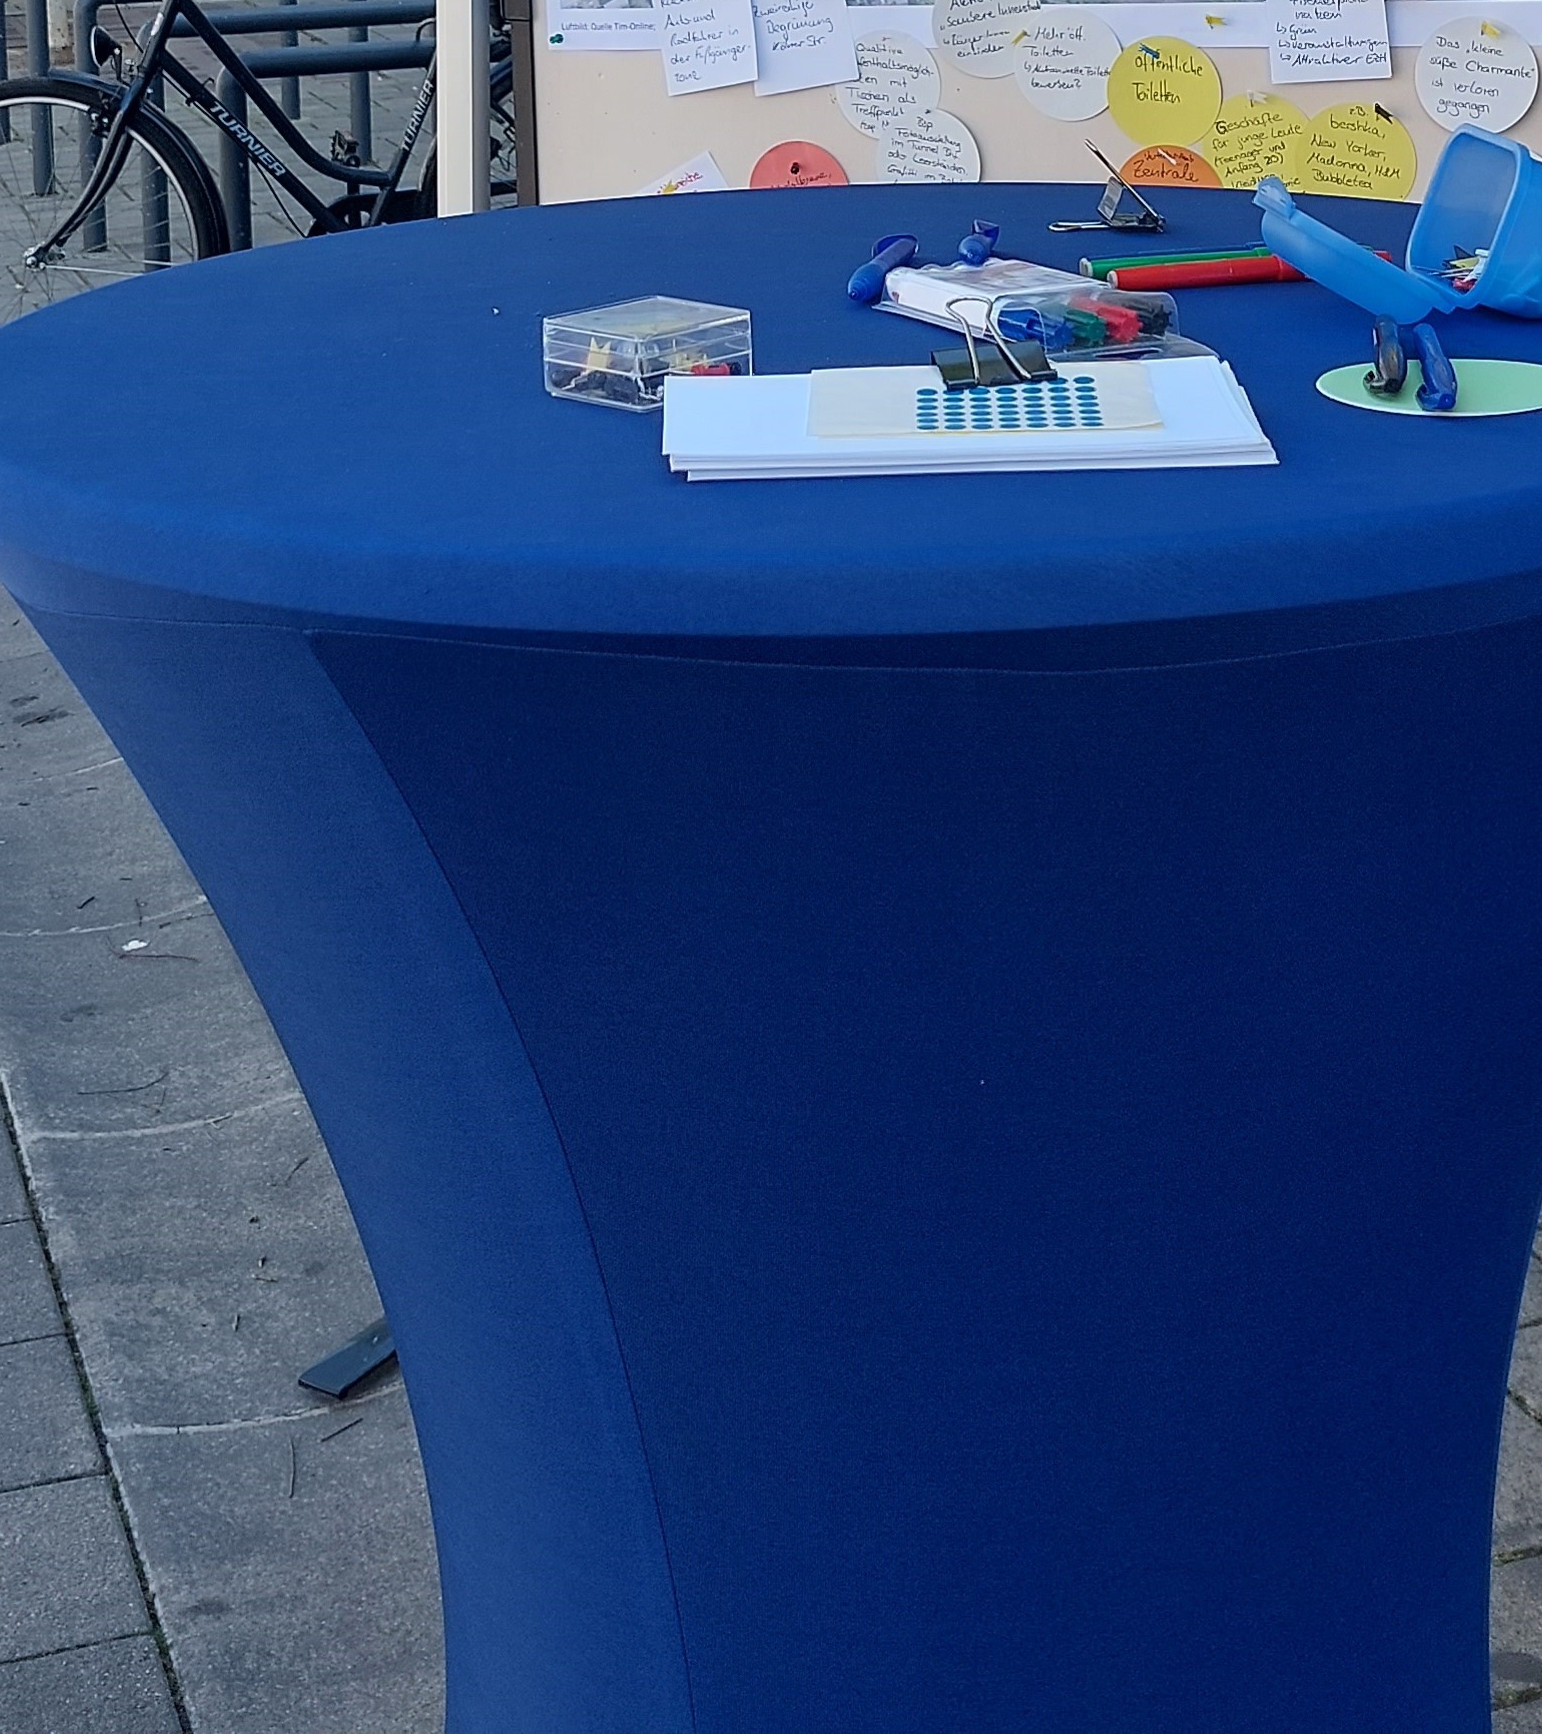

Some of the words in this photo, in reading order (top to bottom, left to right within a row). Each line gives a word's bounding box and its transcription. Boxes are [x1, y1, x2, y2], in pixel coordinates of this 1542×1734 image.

[1436, 36, 1459, 48] Das
[1429, 57, 1457, 70] süße
[1432, 78, 1443, 87] ist
[1454, 81, 1499, 97] verloren
[402, 79, 435, 152] TURNIER
[1437, 98, 1489, 119] gegangen
[1216, 112, 1284, 136] Geschäfte
[209, 100, 286, 176] TURNIER
[1212, 139, 1229, 151] für
[1237, 133, 1268, 150] junge
[1269, 141, 1286, 153] und
[1310, 134, 1336, 149] New
[1346, 141, 1386, 162] Yorker,
[1225, 162, 1263, 178] Anfang
[1306, 153, 1371, 177] Madonna,
[1312, 169, 1372, 190] Bubbletea
